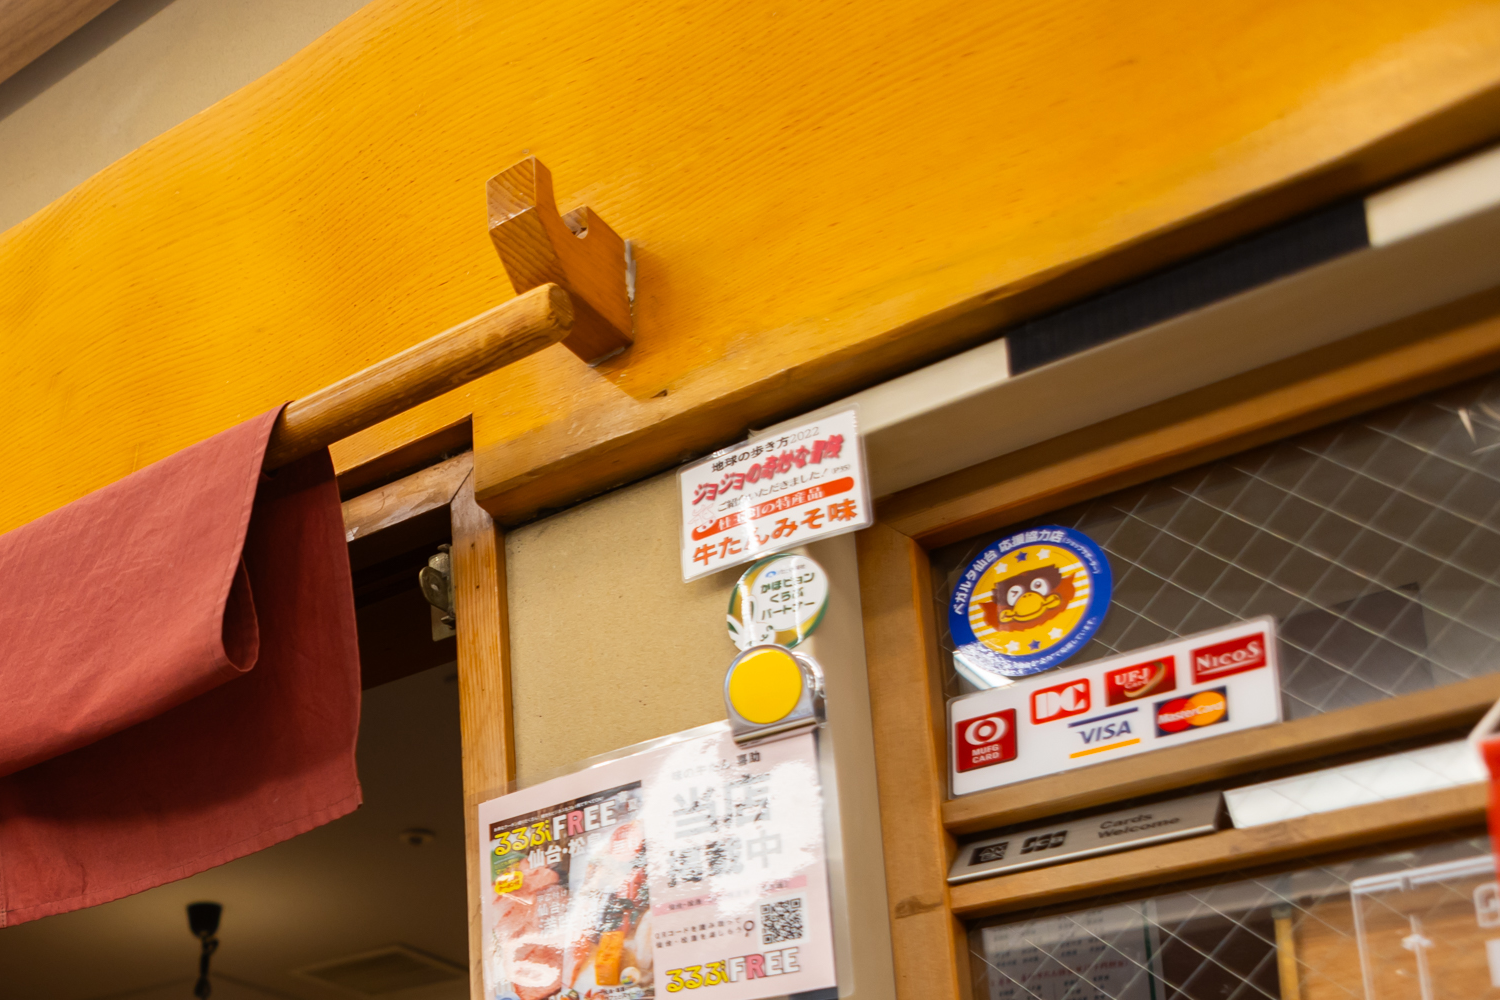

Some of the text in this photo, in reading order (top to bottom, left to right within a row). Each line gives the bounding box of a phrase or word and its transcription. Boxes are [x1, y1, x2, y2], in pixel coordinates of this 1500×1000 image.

[998, 530, 1065, 552] 応援協力店
[954, 550, 998, 615] ベガルタ仙台
[1114, 667, 1150, 686] UFJ
[1157, 700, 1224, 726] MasterCard
[1078, 721, 1132, 744] VISA
[971, 744, 1000, 756] MUFG
[972, 752, 1000, 764] CARD
[1098, 816, 1180, 839] Welcome
[1100, 813, 1153, 829] Cards
